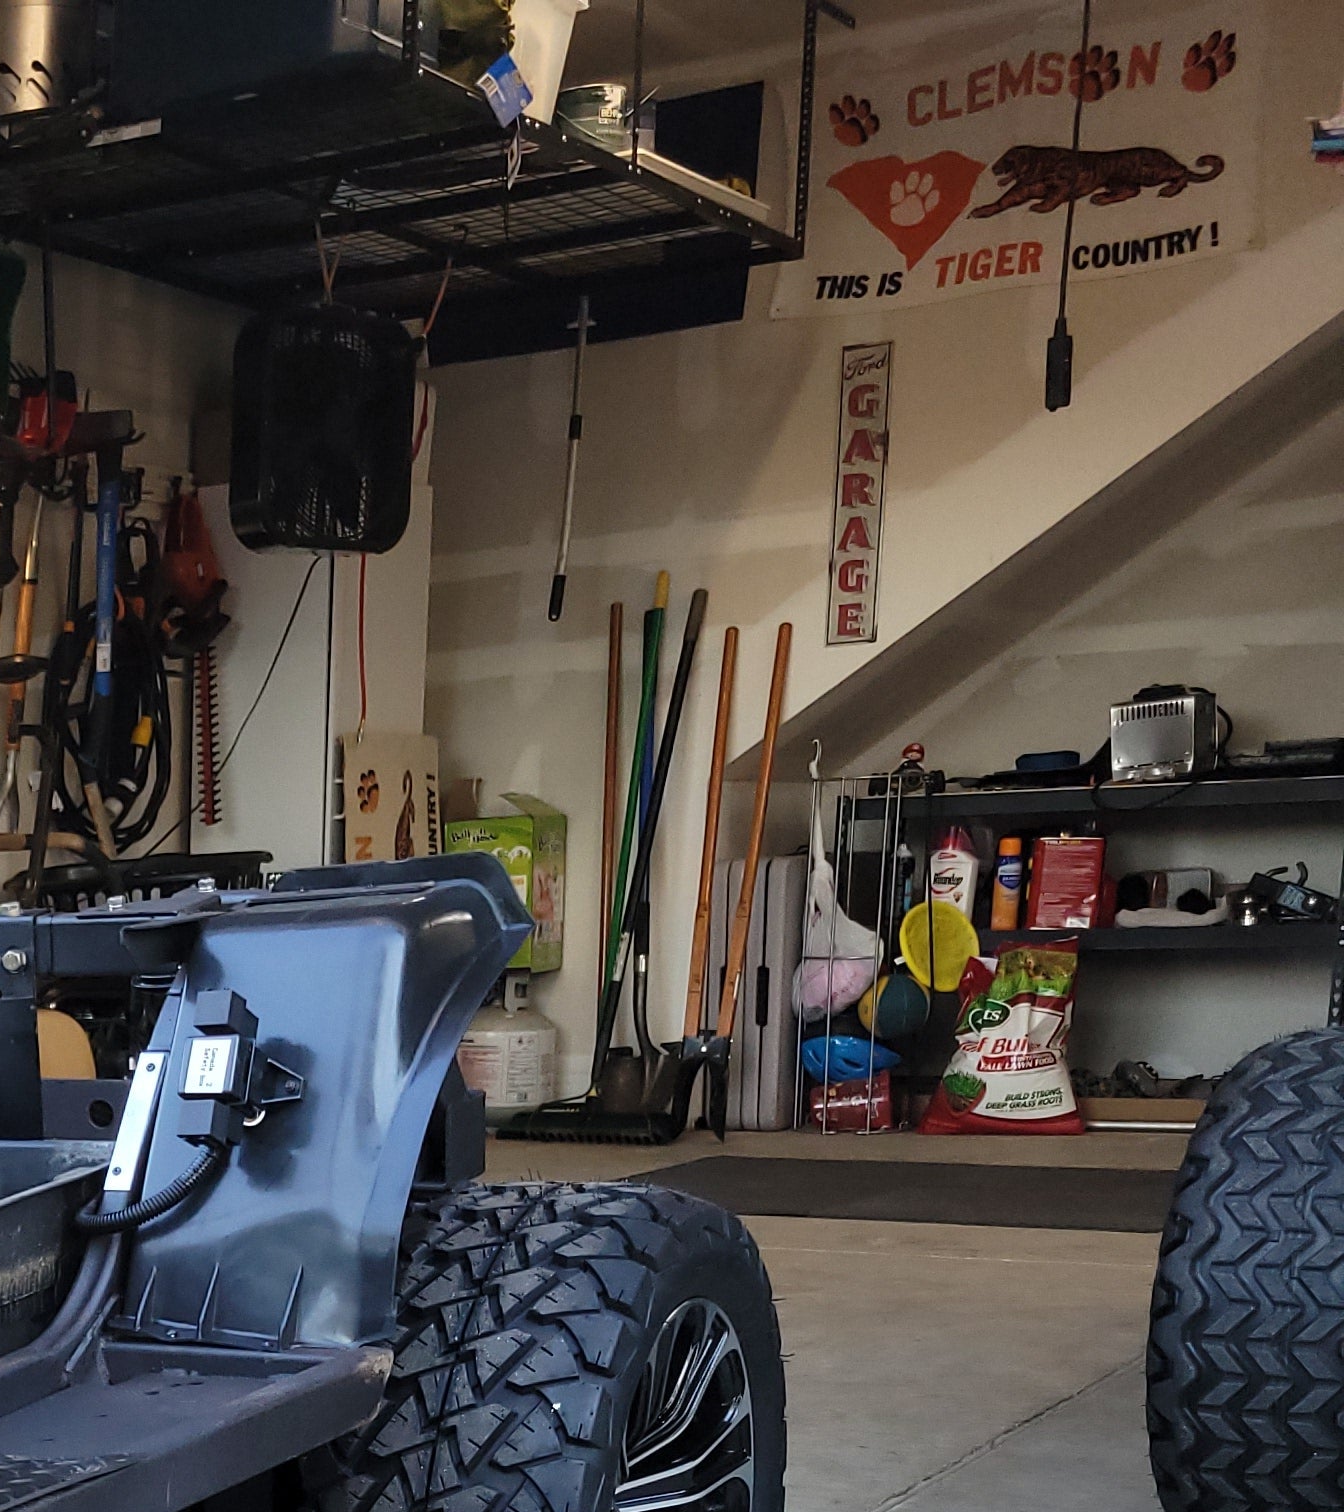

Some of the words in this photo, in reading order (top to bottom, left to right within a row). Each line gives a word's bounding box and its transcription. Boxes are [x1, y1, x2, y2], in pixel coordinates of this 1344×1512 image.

[816, 275, 870, 300] THIS
[877, 271, 903, 297] IS
[935, 242, 1043, 288] TIGER
[1072, 224, 1203, 270] COUNTRY
[844, 353, 887, 381] Ford
[837, 383, 881, 638] GARAGE
[985, 1101, 1008, 1109] DEEP
[1008, 1099, 1037, 1109] GRASS
[1037, 1095, 1064, 1106] ROOTS
[1004, 1092, 1030, 1102] BUILD
